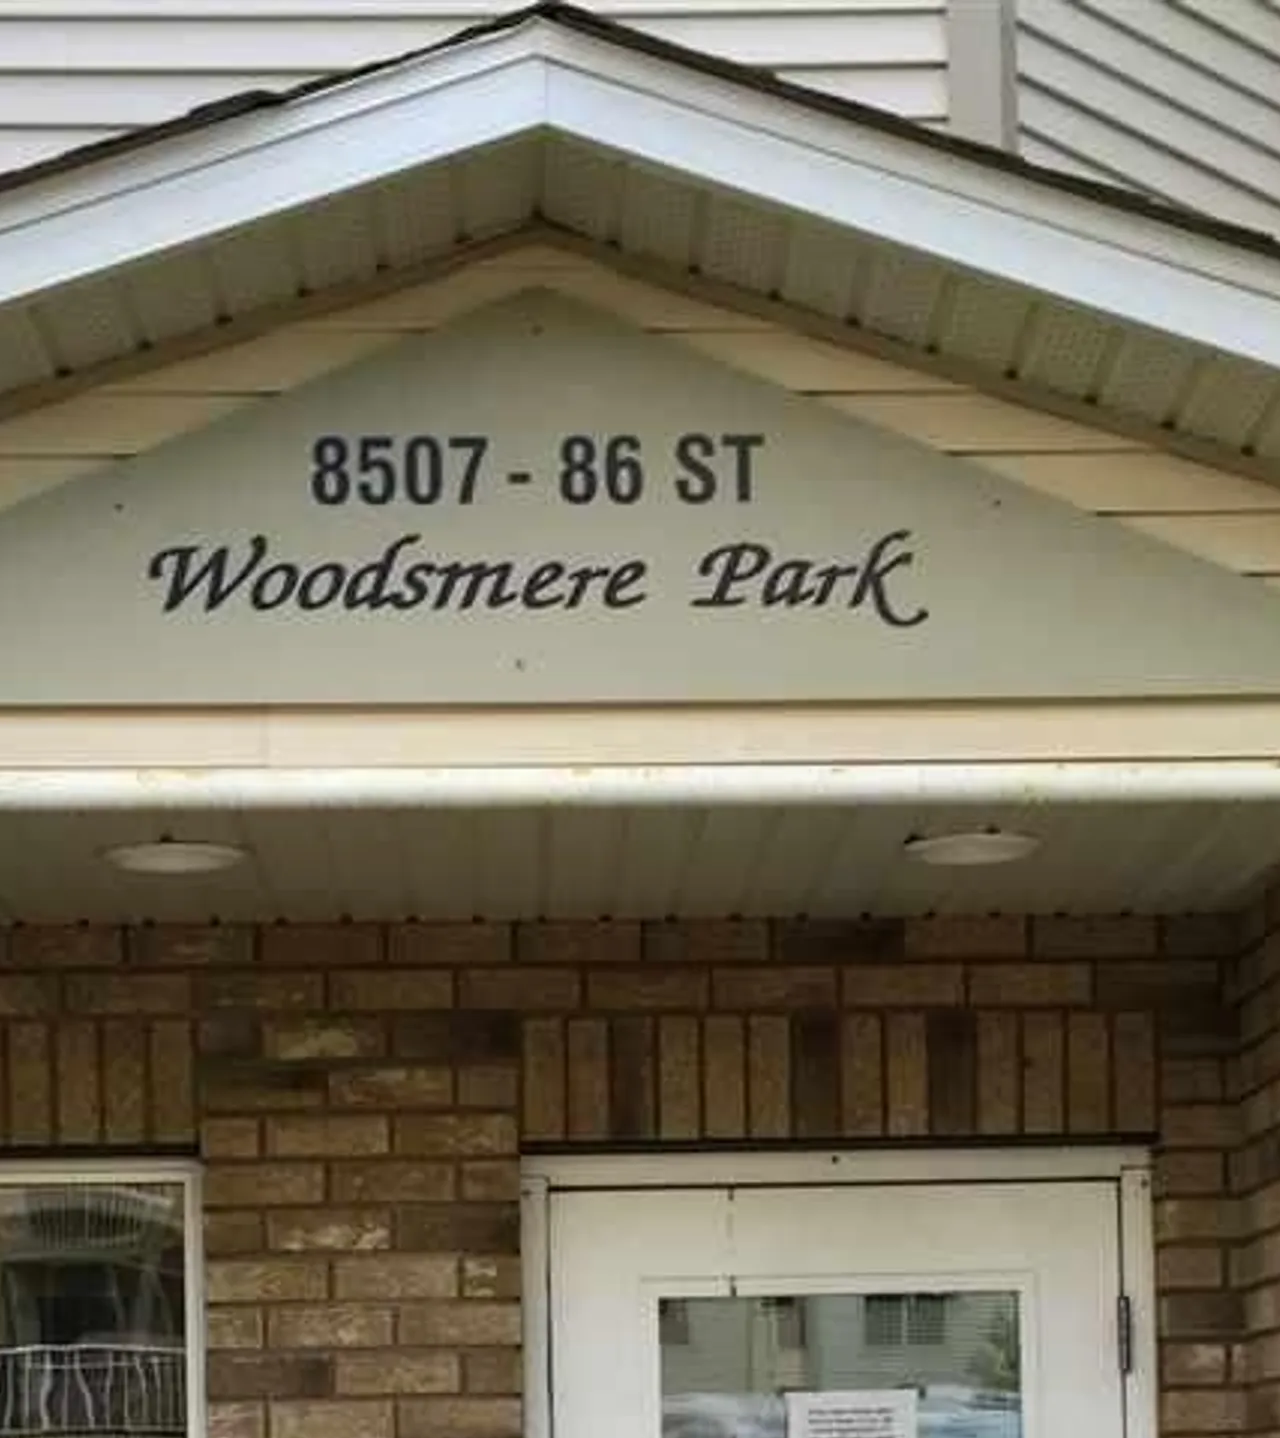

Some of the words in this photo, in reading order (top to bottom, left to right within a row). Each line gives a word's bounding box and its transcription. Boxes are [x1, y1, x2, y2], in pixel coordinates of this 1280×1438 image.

[311, 435, 489, 505] 8507
[507, 470, 532, 485] -
[559, 434, 644, 505] 86
[675, 432, 766, 503] ST
[147, 534, 648, 613] Woodsmere
[690, 528, 930, 627] Park
